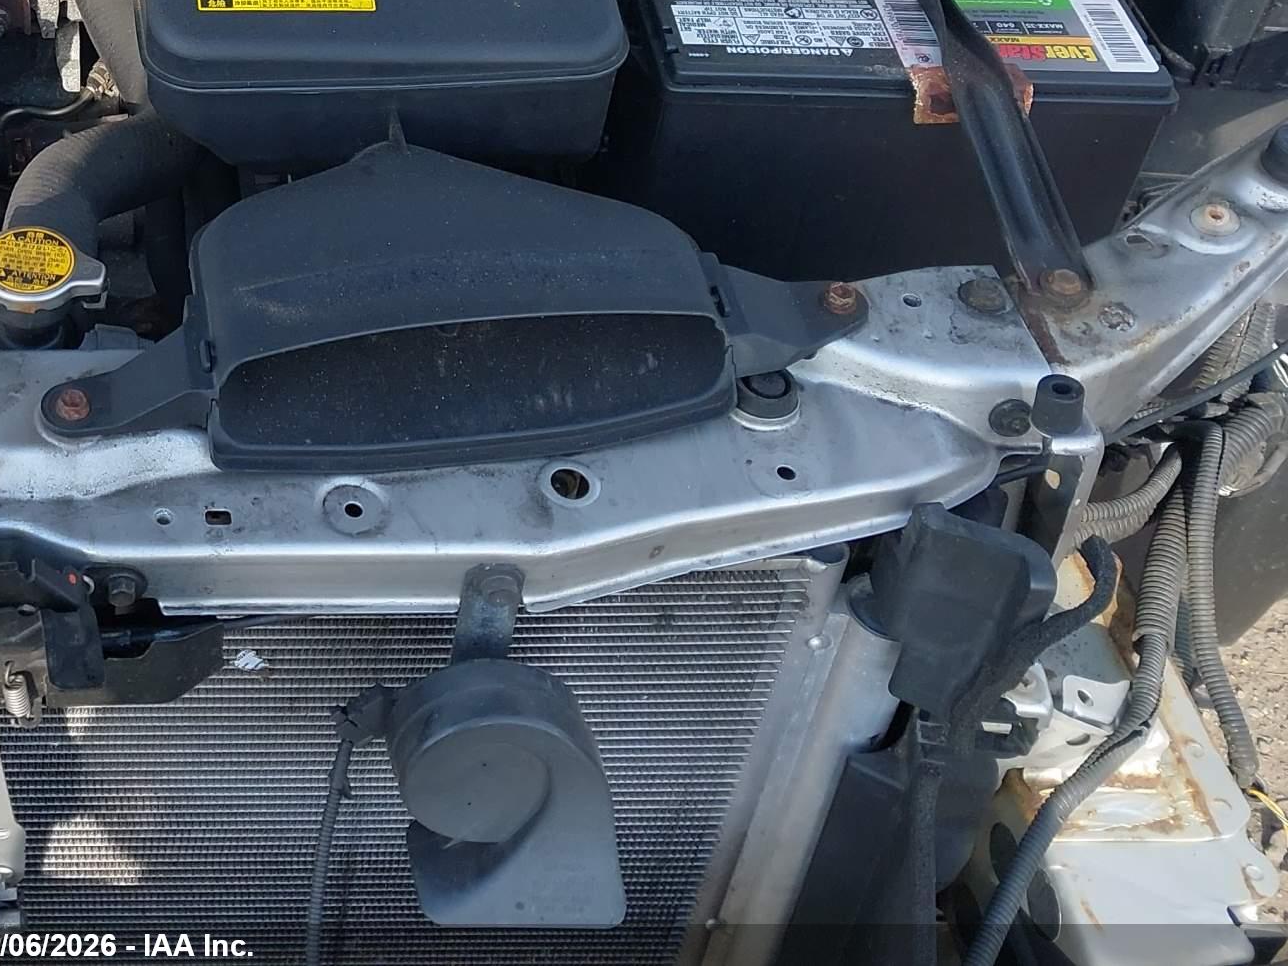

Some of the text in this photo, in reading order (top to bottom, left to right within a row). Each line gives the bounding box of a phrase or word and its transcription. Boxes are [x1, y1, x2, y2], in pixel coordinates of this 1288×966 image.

[726, 46, 840, 56] DANGER/POISON
[998, 44, 1099, 62] EverStar
[17, 236, 59, 246] CAUTION
[11, 269, 57, 281] ATTENTION
